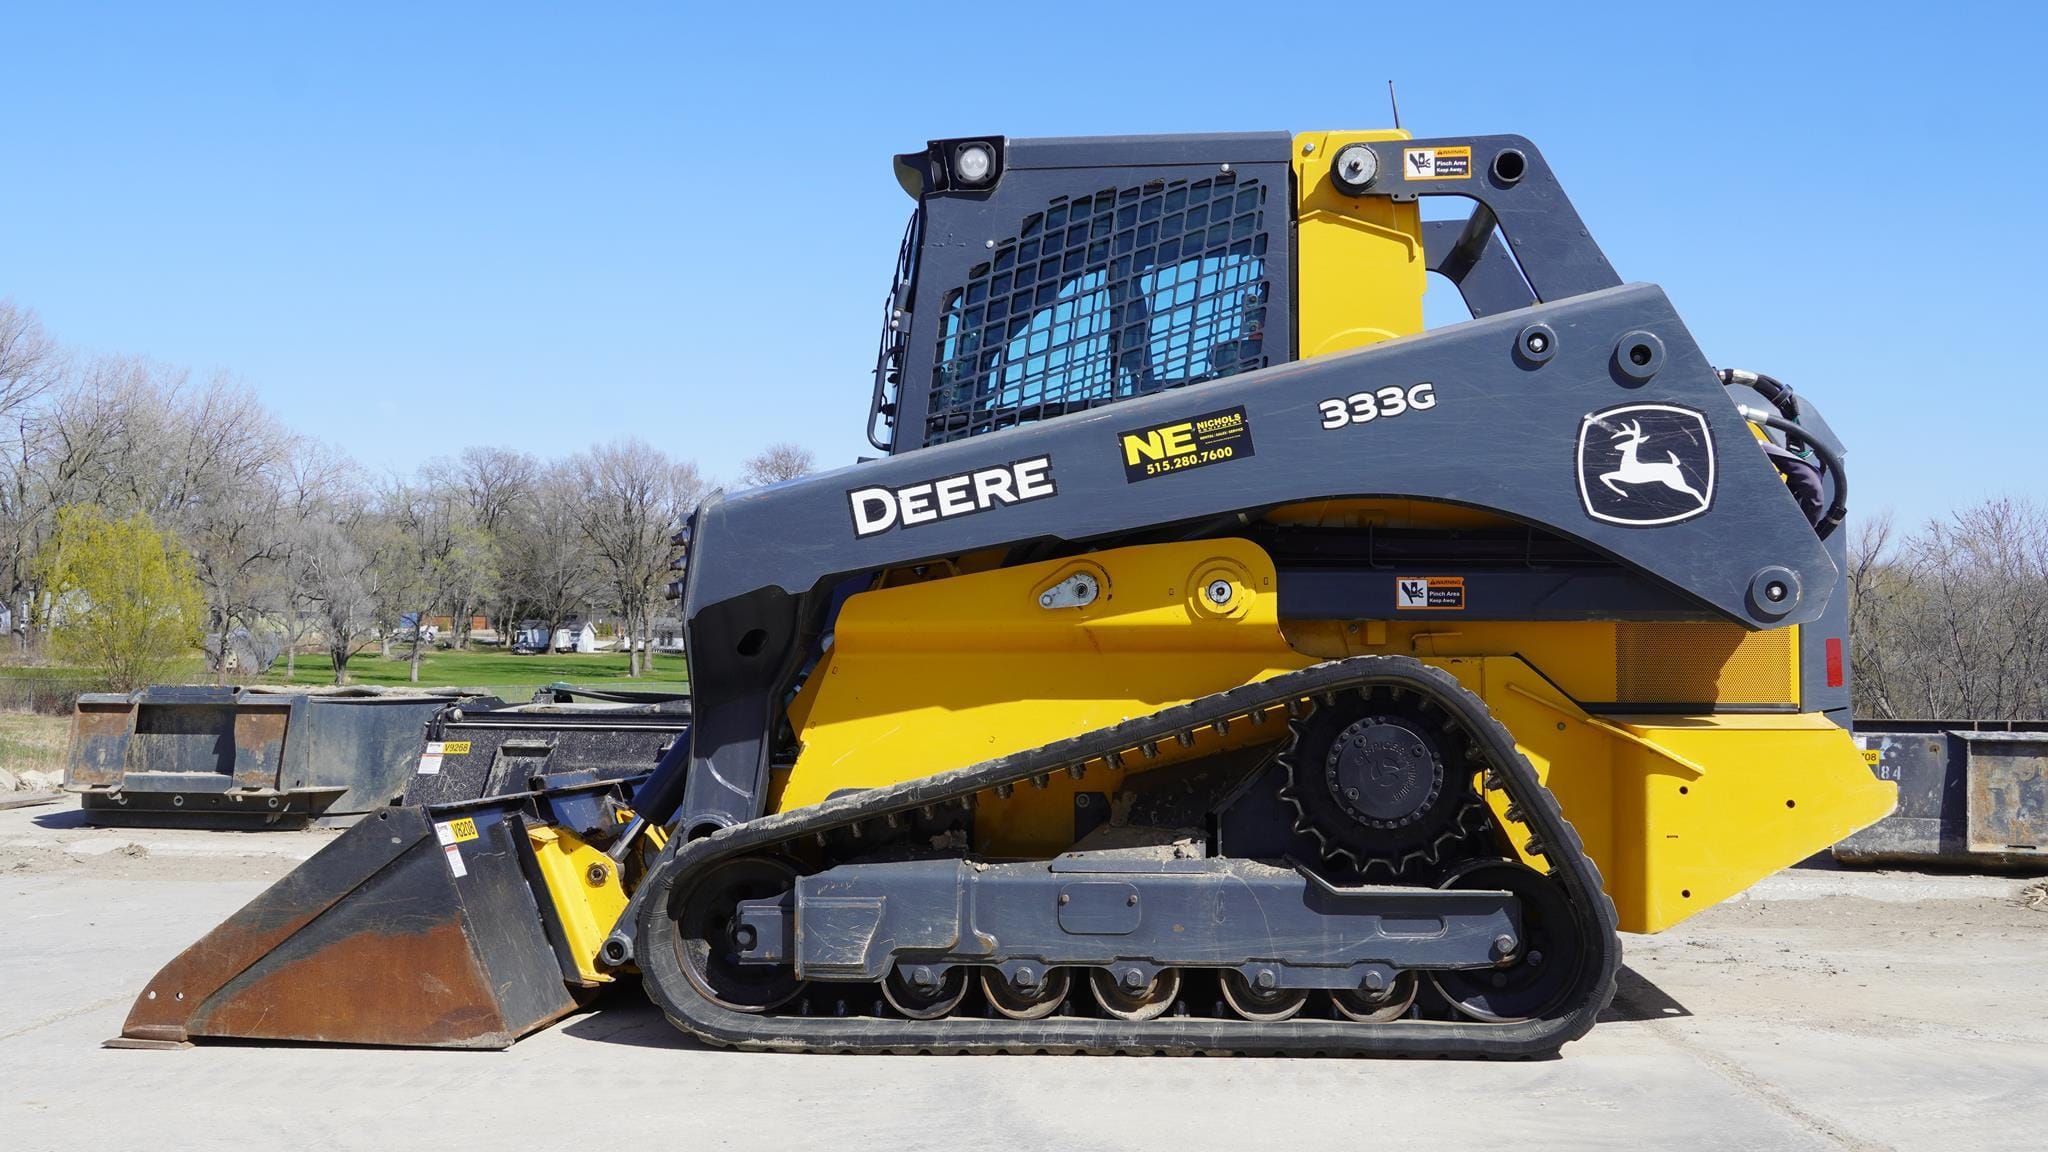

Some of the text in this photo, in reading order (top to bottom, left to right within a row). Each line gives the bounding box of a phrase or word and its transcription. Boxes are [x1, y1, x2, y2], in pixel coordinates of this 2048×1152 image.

[1319, 382, 1437, 429] 333G
[1196, 413, 1242, 430] NICHOLS
[1123, 422, 1197, 466] NE
[1146, 446, 1233, 475] 515.280.7600
[850, 457, 1054, 535] DEERE
[444, 743, 469, 752] V9268
[1862, 752, 1877, 761] 08
